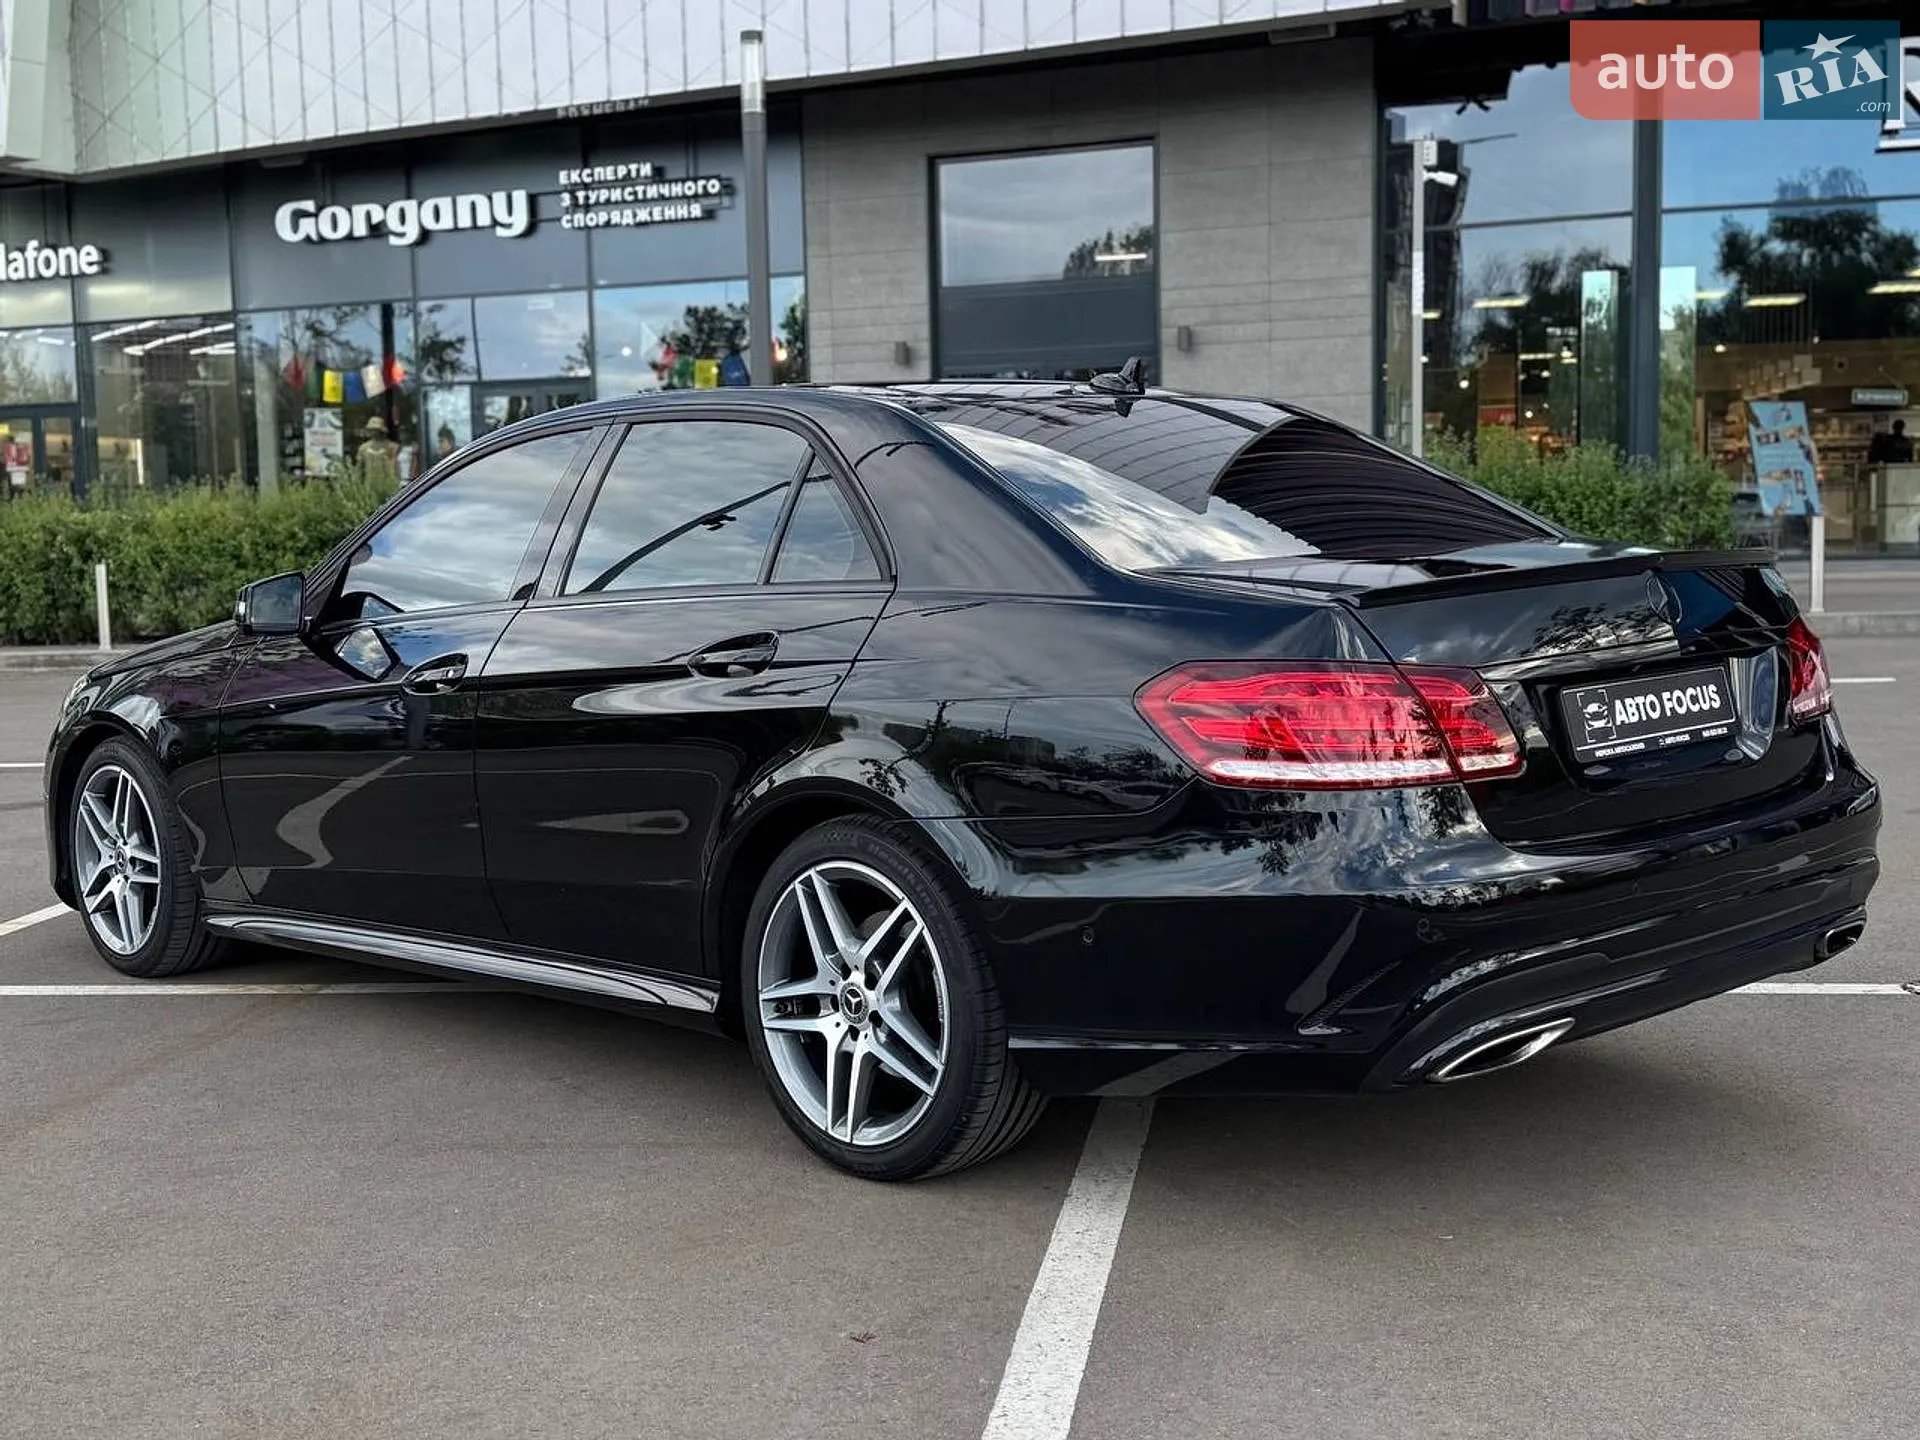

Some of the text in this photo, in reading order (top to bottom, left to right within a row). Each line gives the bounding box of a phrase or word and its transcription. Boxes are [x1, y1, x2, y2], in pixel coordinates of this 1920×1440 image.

[559, 162, 652, 185] ЕКСПЕРТИ
[560, 178, 721, 207] З ТУРИСТИЧНОГО
[274, 189, 528, 246] Gorgany
[561, 203, 702, 229] СПОРЯДЖЕННЯ
[1614, 683, 1721, 726] АВТО FOCUS
